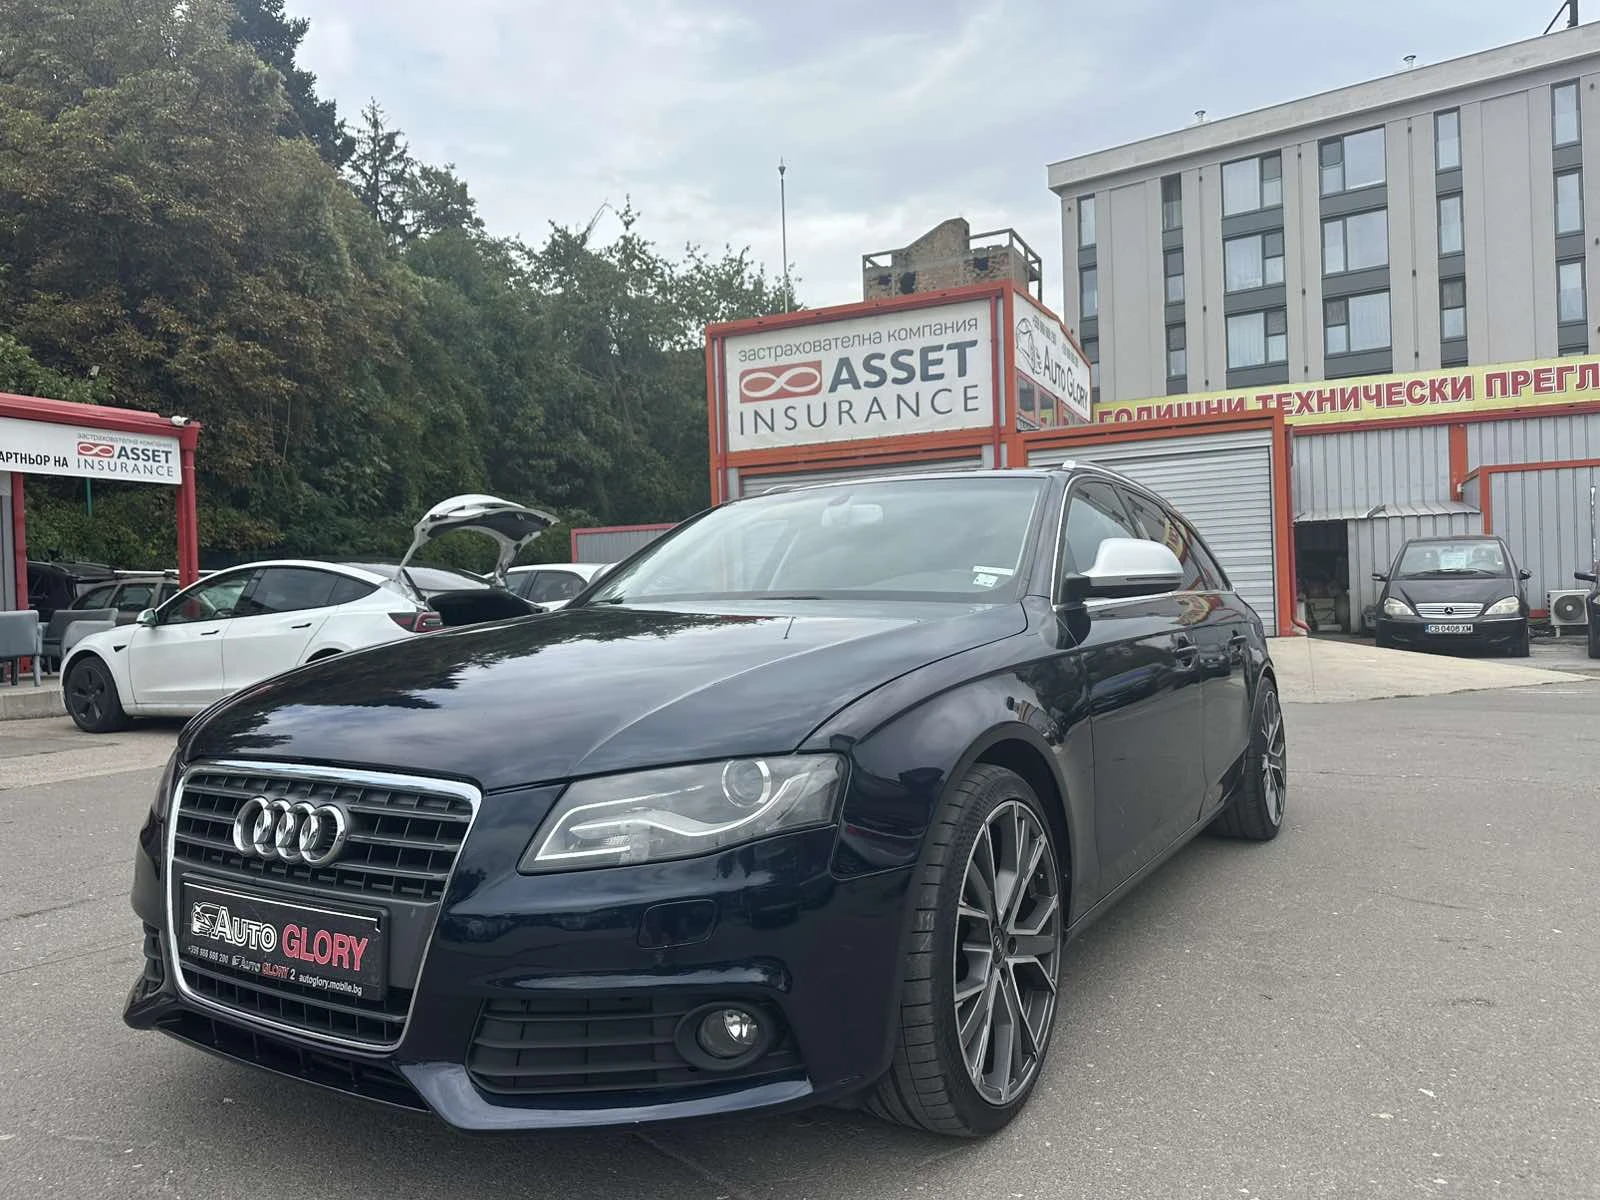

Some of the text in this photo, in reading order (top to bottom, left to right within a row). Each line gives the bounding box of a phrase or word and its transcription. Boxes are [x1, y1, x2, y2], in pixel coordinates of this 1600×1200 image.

[739, 317, 978, 362] застрахователна компания
[828, 340, 978, 393] ASSET
[1255, 374, 1474, 415] ТЕХНИЧЕСКИ
[1484, 362, 1600, 400] ПРЕГЛ
[739, 384, 979, 435] INSURANCE
[54, 456, 69, 468] НА
[77, 457, 173, 477] INSURANCE
[117, 445, 172, 464] ASSET
[282, 923, 368, 971] GLORY
[290, 968, 296, 980] 2
[299, 974, 363, 997] autoglory.mobile.bg
